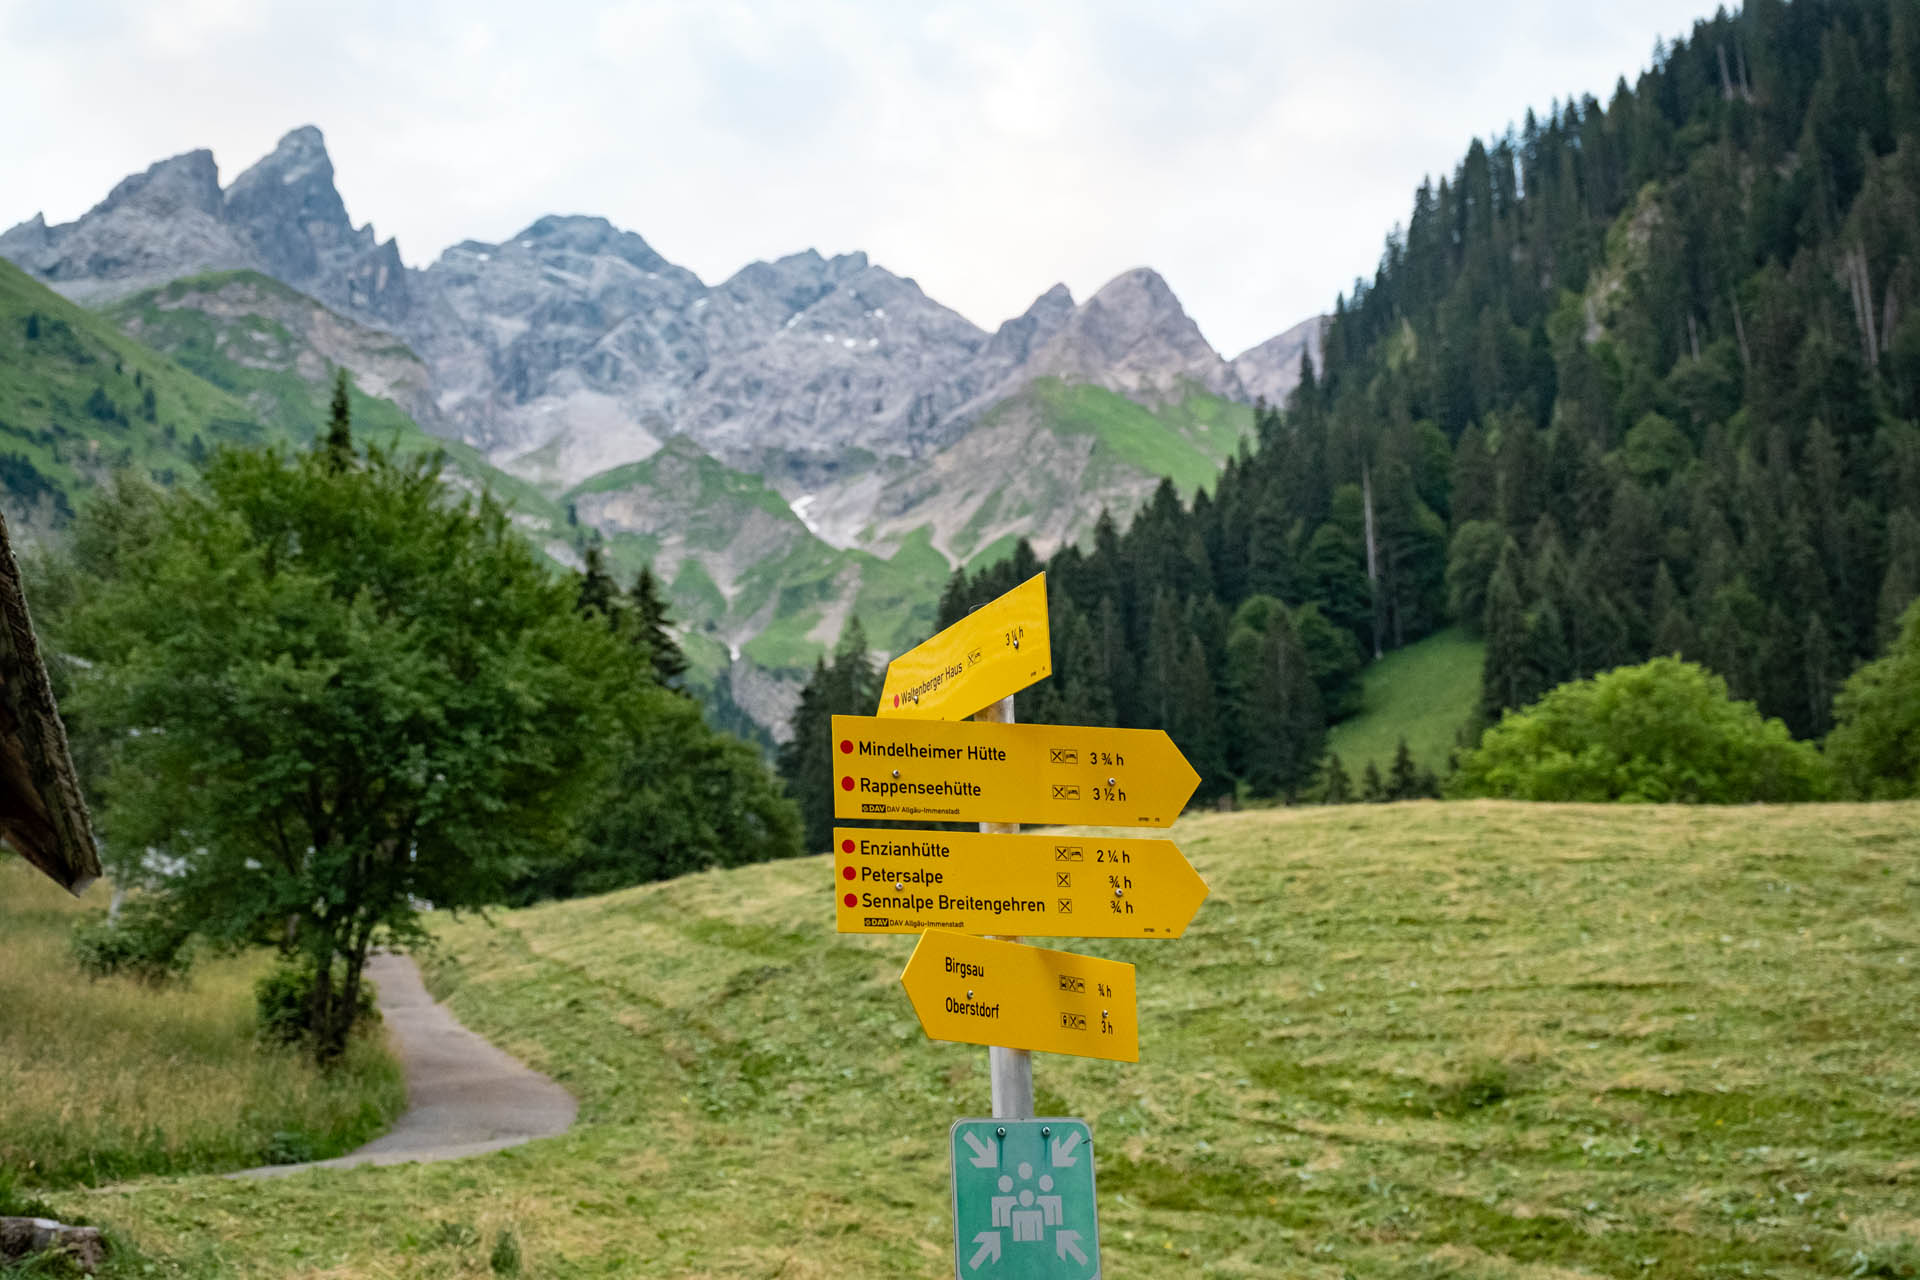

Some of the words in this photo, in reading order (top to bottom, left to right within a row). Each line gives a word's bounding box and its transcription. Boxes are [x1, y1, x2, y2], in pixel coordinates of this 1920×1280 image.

[901, 673, 944, 705] Waltenberger
[945, 662, 963, 681] Haus
[1004, 632, 1010, 646] 3
[1019, 626, 1024, 639] h
[859, 741, 963, 760] Mindelheimer
[967, 745, 1007, 761] Hütte
[1090, 752, 1098, 765] 3
[1116, 753, 1124, 766] h
[860, 777, 981, 797] Rappenseehütte
[1093, 788, 1100, 801] 3
[1118, 788, 1126, 801] h
[901, 806, 960, 815] Allgäu-Immenstadt
[860, 840, 950, 858] Enzianhütte
[1097, 849, 1104, 863] 2
[1122, 850, 1130, 863] h
[861, 866, 943, 887] Petersalpe
[1124, 876, 1132, 889] h
[862, 893, 934, 912] Sennalpe
[938, 895, 1046, 915] Breitengehren
[1125, 901, 1134, 914] h
[889, 919, 903, 927] DAV
[904, 919, 964, 929] Allgäu-Immenstadt
[945, 956, 984, 978] Birgsau
[1106, 984, 1112, 998] h
[945, 997, 1000, 1019] Oberstdorf
[1101, 1020, 1106, 1034] 3
[1108, 1021, 1113, 1035] h
